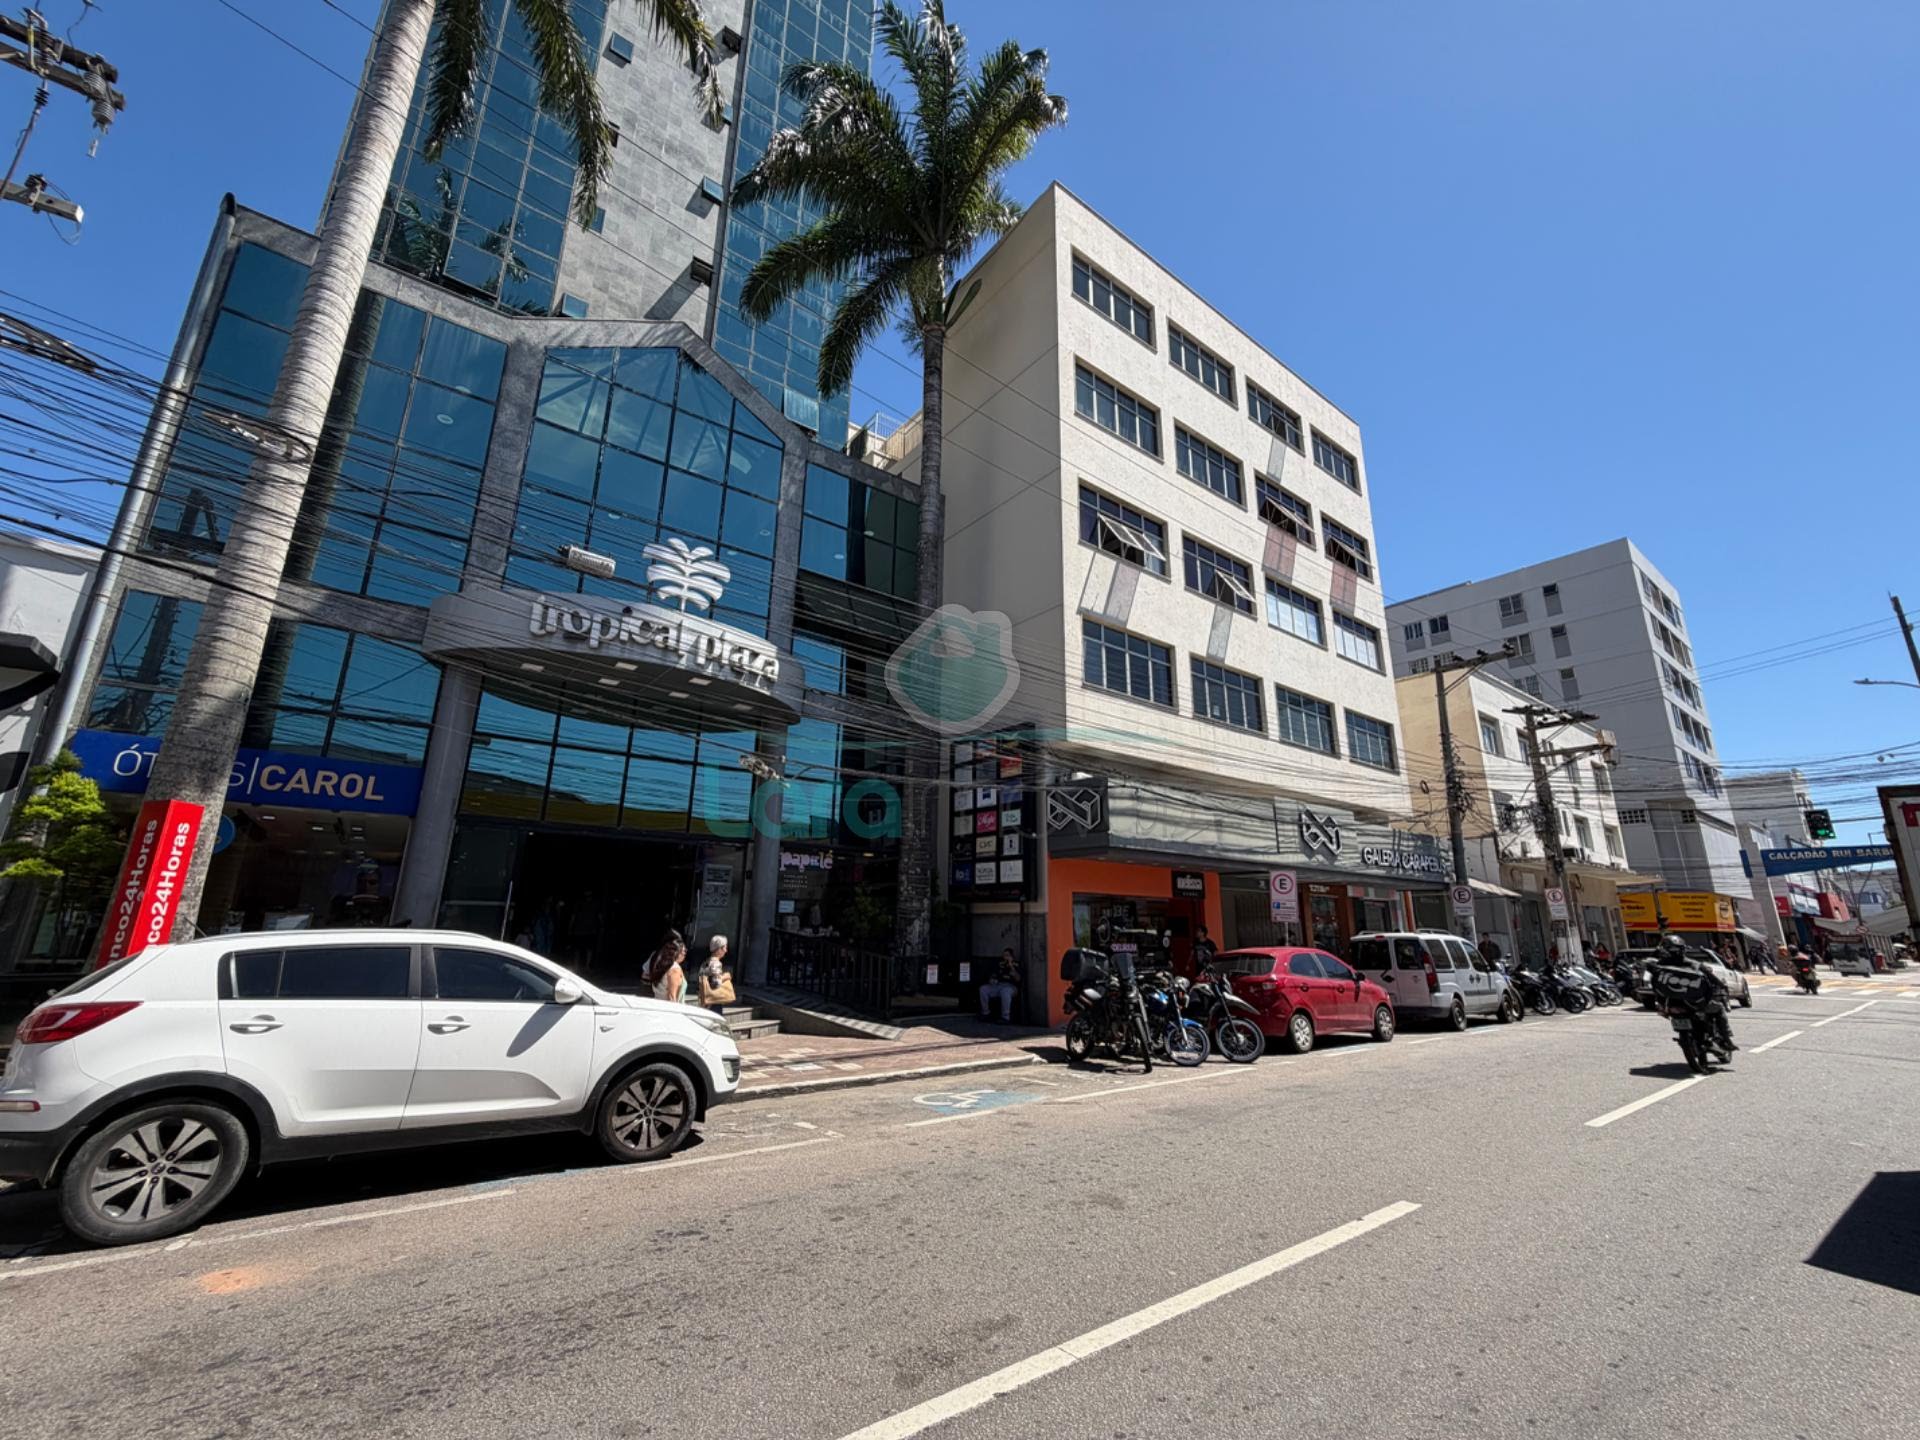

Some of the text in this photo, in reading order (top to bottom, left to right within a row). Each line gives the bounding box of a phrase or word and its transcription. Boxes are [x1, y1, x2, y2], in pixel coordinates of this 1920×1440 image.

[529, 594, 780, 681] tropical plaza
[113, 743, 384, 801] ÓTS CAROL
[1363, 846, 1400, 867] GALERIA
[1831, 849, 1852, 858] RUI
[106, 819, 158, 965] nco24Horas
[144, 821, 191, 948] co24Horas
[1279, 878, 1287, 890] E
[1458, 891, 1466, 900] E
[1657, 971, 1702, 989] ifood
